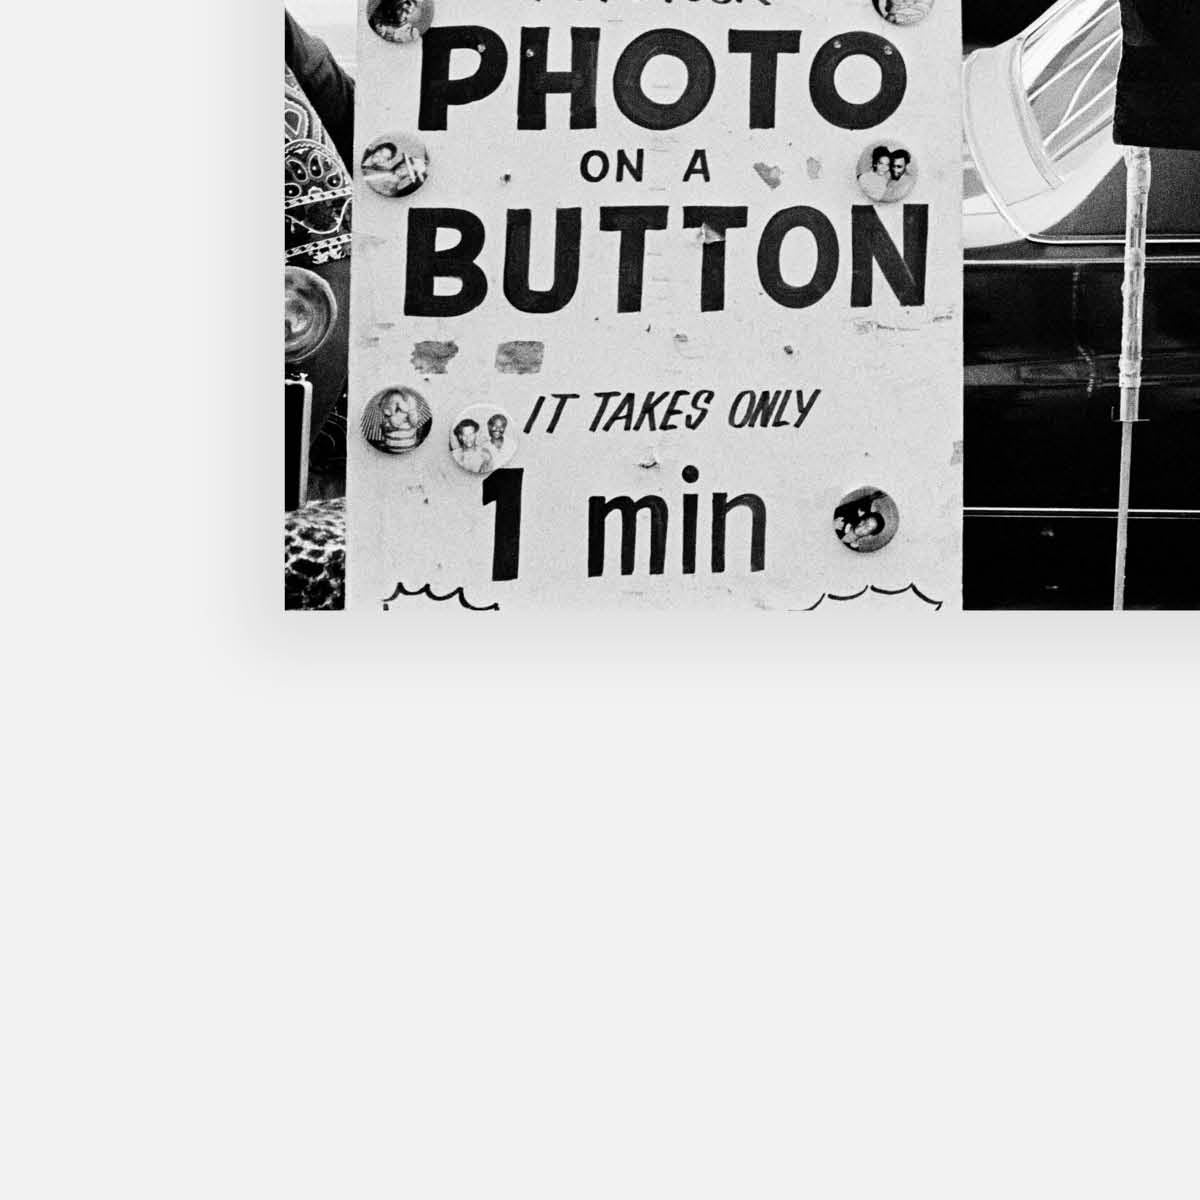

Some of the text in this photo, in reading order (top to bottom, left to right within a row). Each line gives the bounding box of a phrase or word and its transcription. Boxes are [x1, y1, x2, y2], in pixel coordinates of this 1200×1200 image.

[417, 25, 907, 132] PHOTO
[579, 148, 711, 183] ON A
[403, 203, 929, 318] BUTTON
[522, 388, 822, 435] IT TAKES ONLY
[482, 461, 767, 582] 1 min
